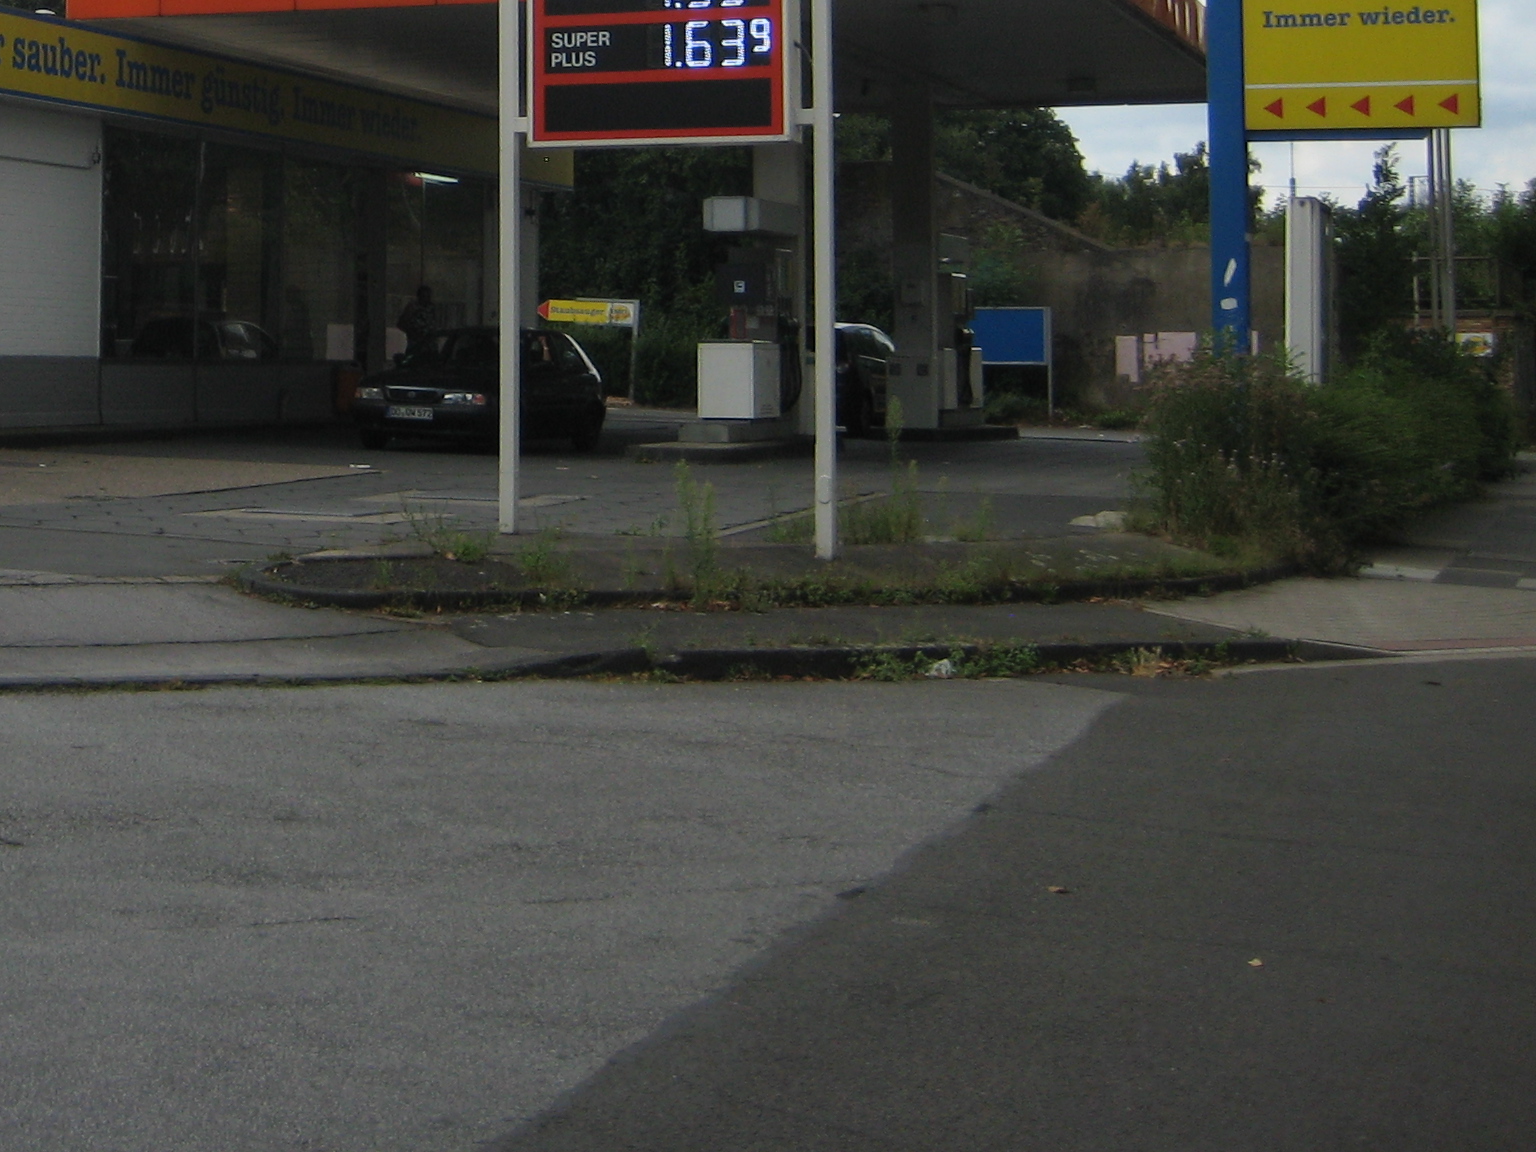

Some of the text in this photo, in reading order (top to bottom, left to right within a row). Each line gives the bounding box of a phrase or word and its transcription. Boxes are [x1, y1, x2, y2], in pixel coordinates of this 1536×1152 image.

[1263, 6, 1455, 28] Immer wieder.
[550, 51, 596, 68] PLUS
[551, 17, 771, 68] SUPER 1.639
[12, 37, 106, 84] sauber.
[116, 49, 197, 100] Immer
[201, 66, 285, 126] günstig.
[292, 85, 356, 130] Immer
[359, 105, 422, 141] wieder.
